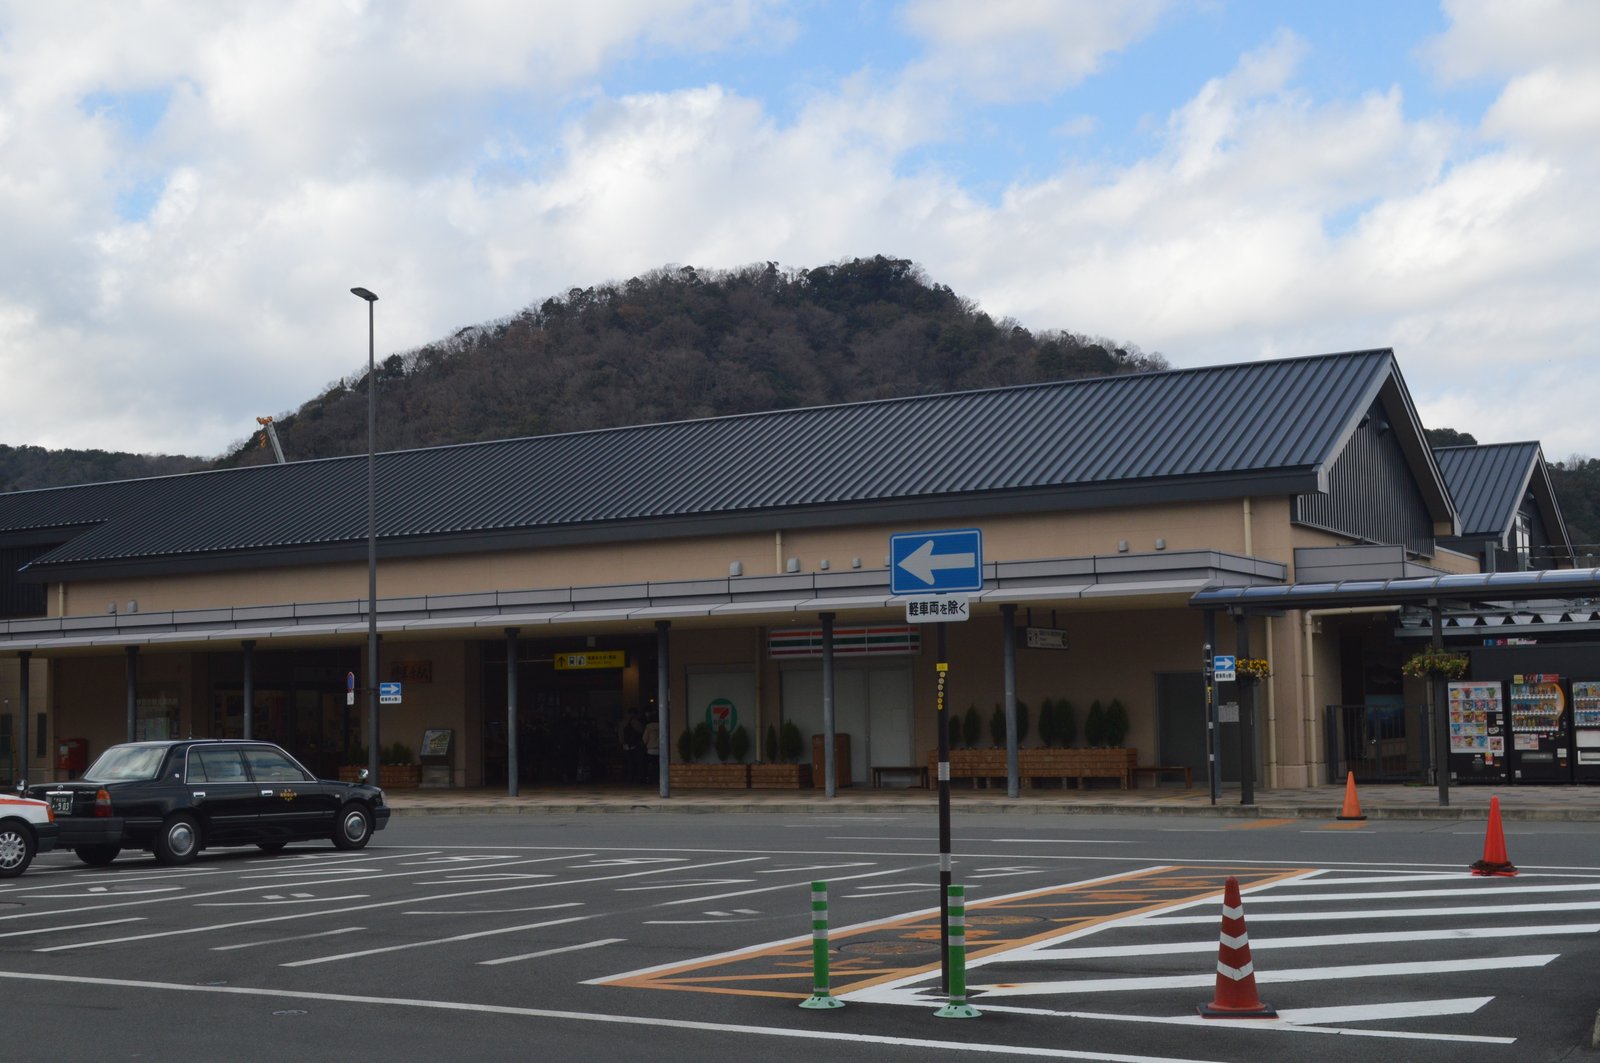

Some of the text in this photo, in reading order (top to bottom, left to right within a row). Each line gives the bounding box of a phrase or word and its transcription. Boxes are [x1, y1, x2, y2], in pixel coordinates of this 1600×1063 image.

[909, 601, 966, 616] 軽車両を除く
